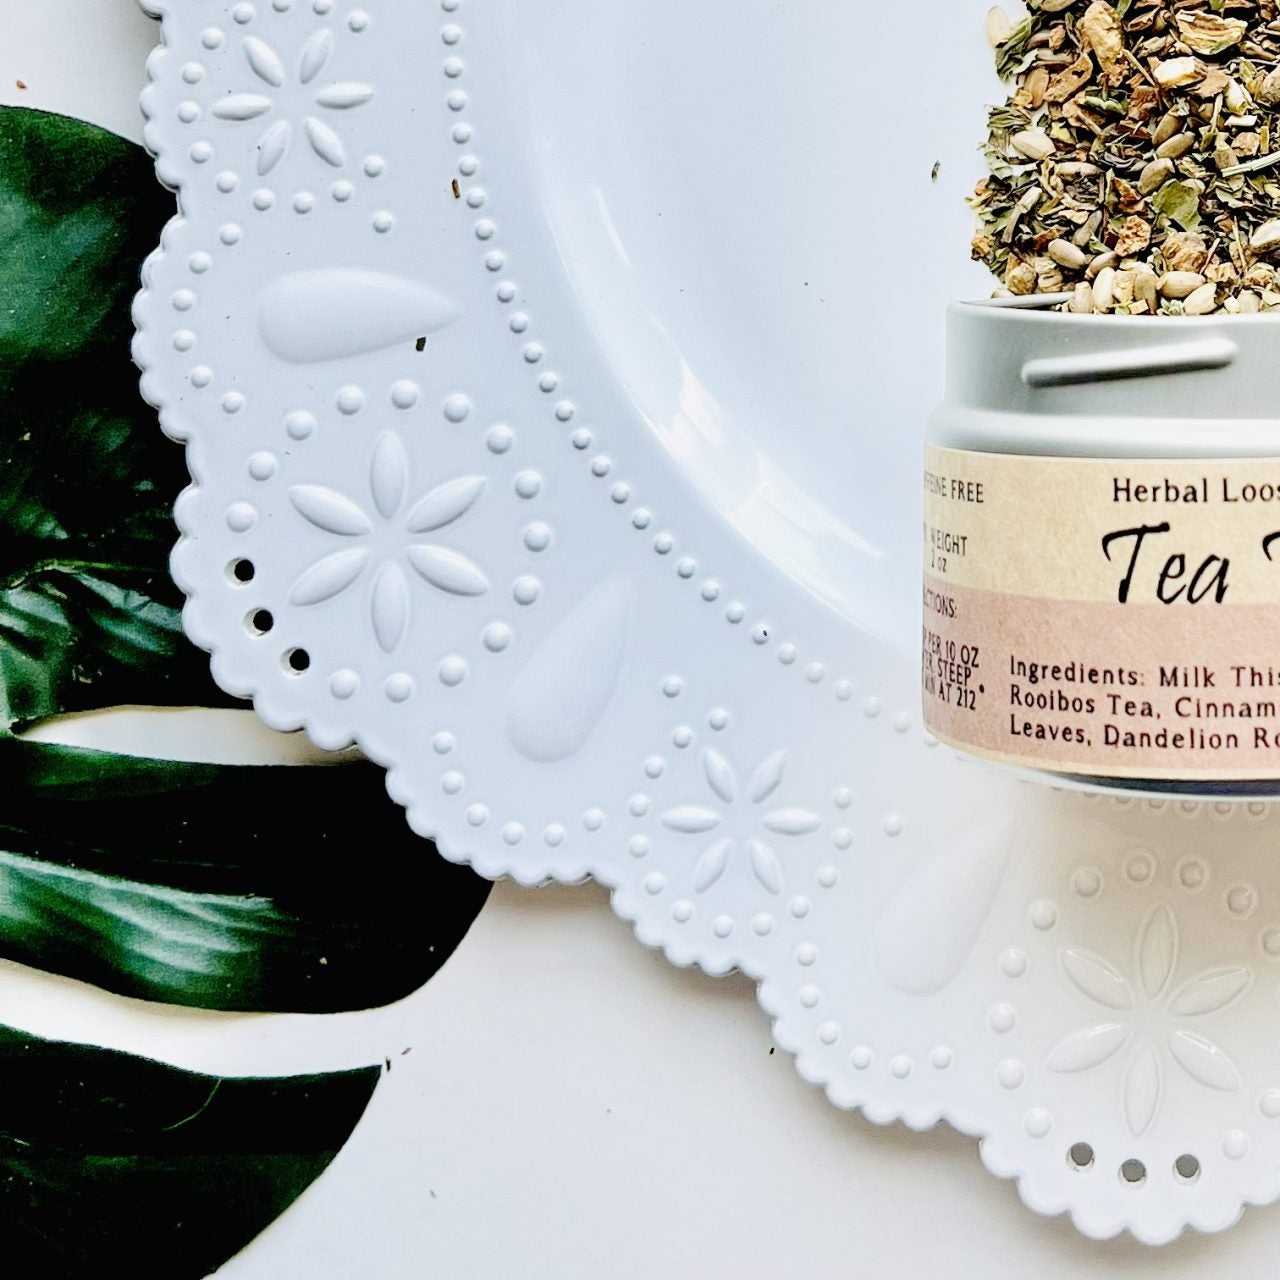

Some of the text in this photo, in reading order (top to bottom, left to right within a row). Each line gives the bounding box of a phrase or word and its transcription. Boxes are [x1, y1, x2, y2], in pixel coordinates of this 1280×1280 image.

[951, 479, 984, 503] FREE
[1112, 477, 1208, 503] Herbal
[1101, 521, 1230, 605] Tea
[945, 640, 956, 662] 10
[960, 644, 979, 668] OZ
[937, 657, 971, 686] STEEP
[1010, 655, 1146, 685] Ingredients:
[1159, 665, 1216, 688] Milk
[938, 680, 952, 703] AT
[1010, 684, 1096, 713] Rooibos
[1107, 694, 1161, 720] Tea,
[1010, 714, 1092, 746] Leaves,
[1104, 724, 1239, 750] Dandelion
